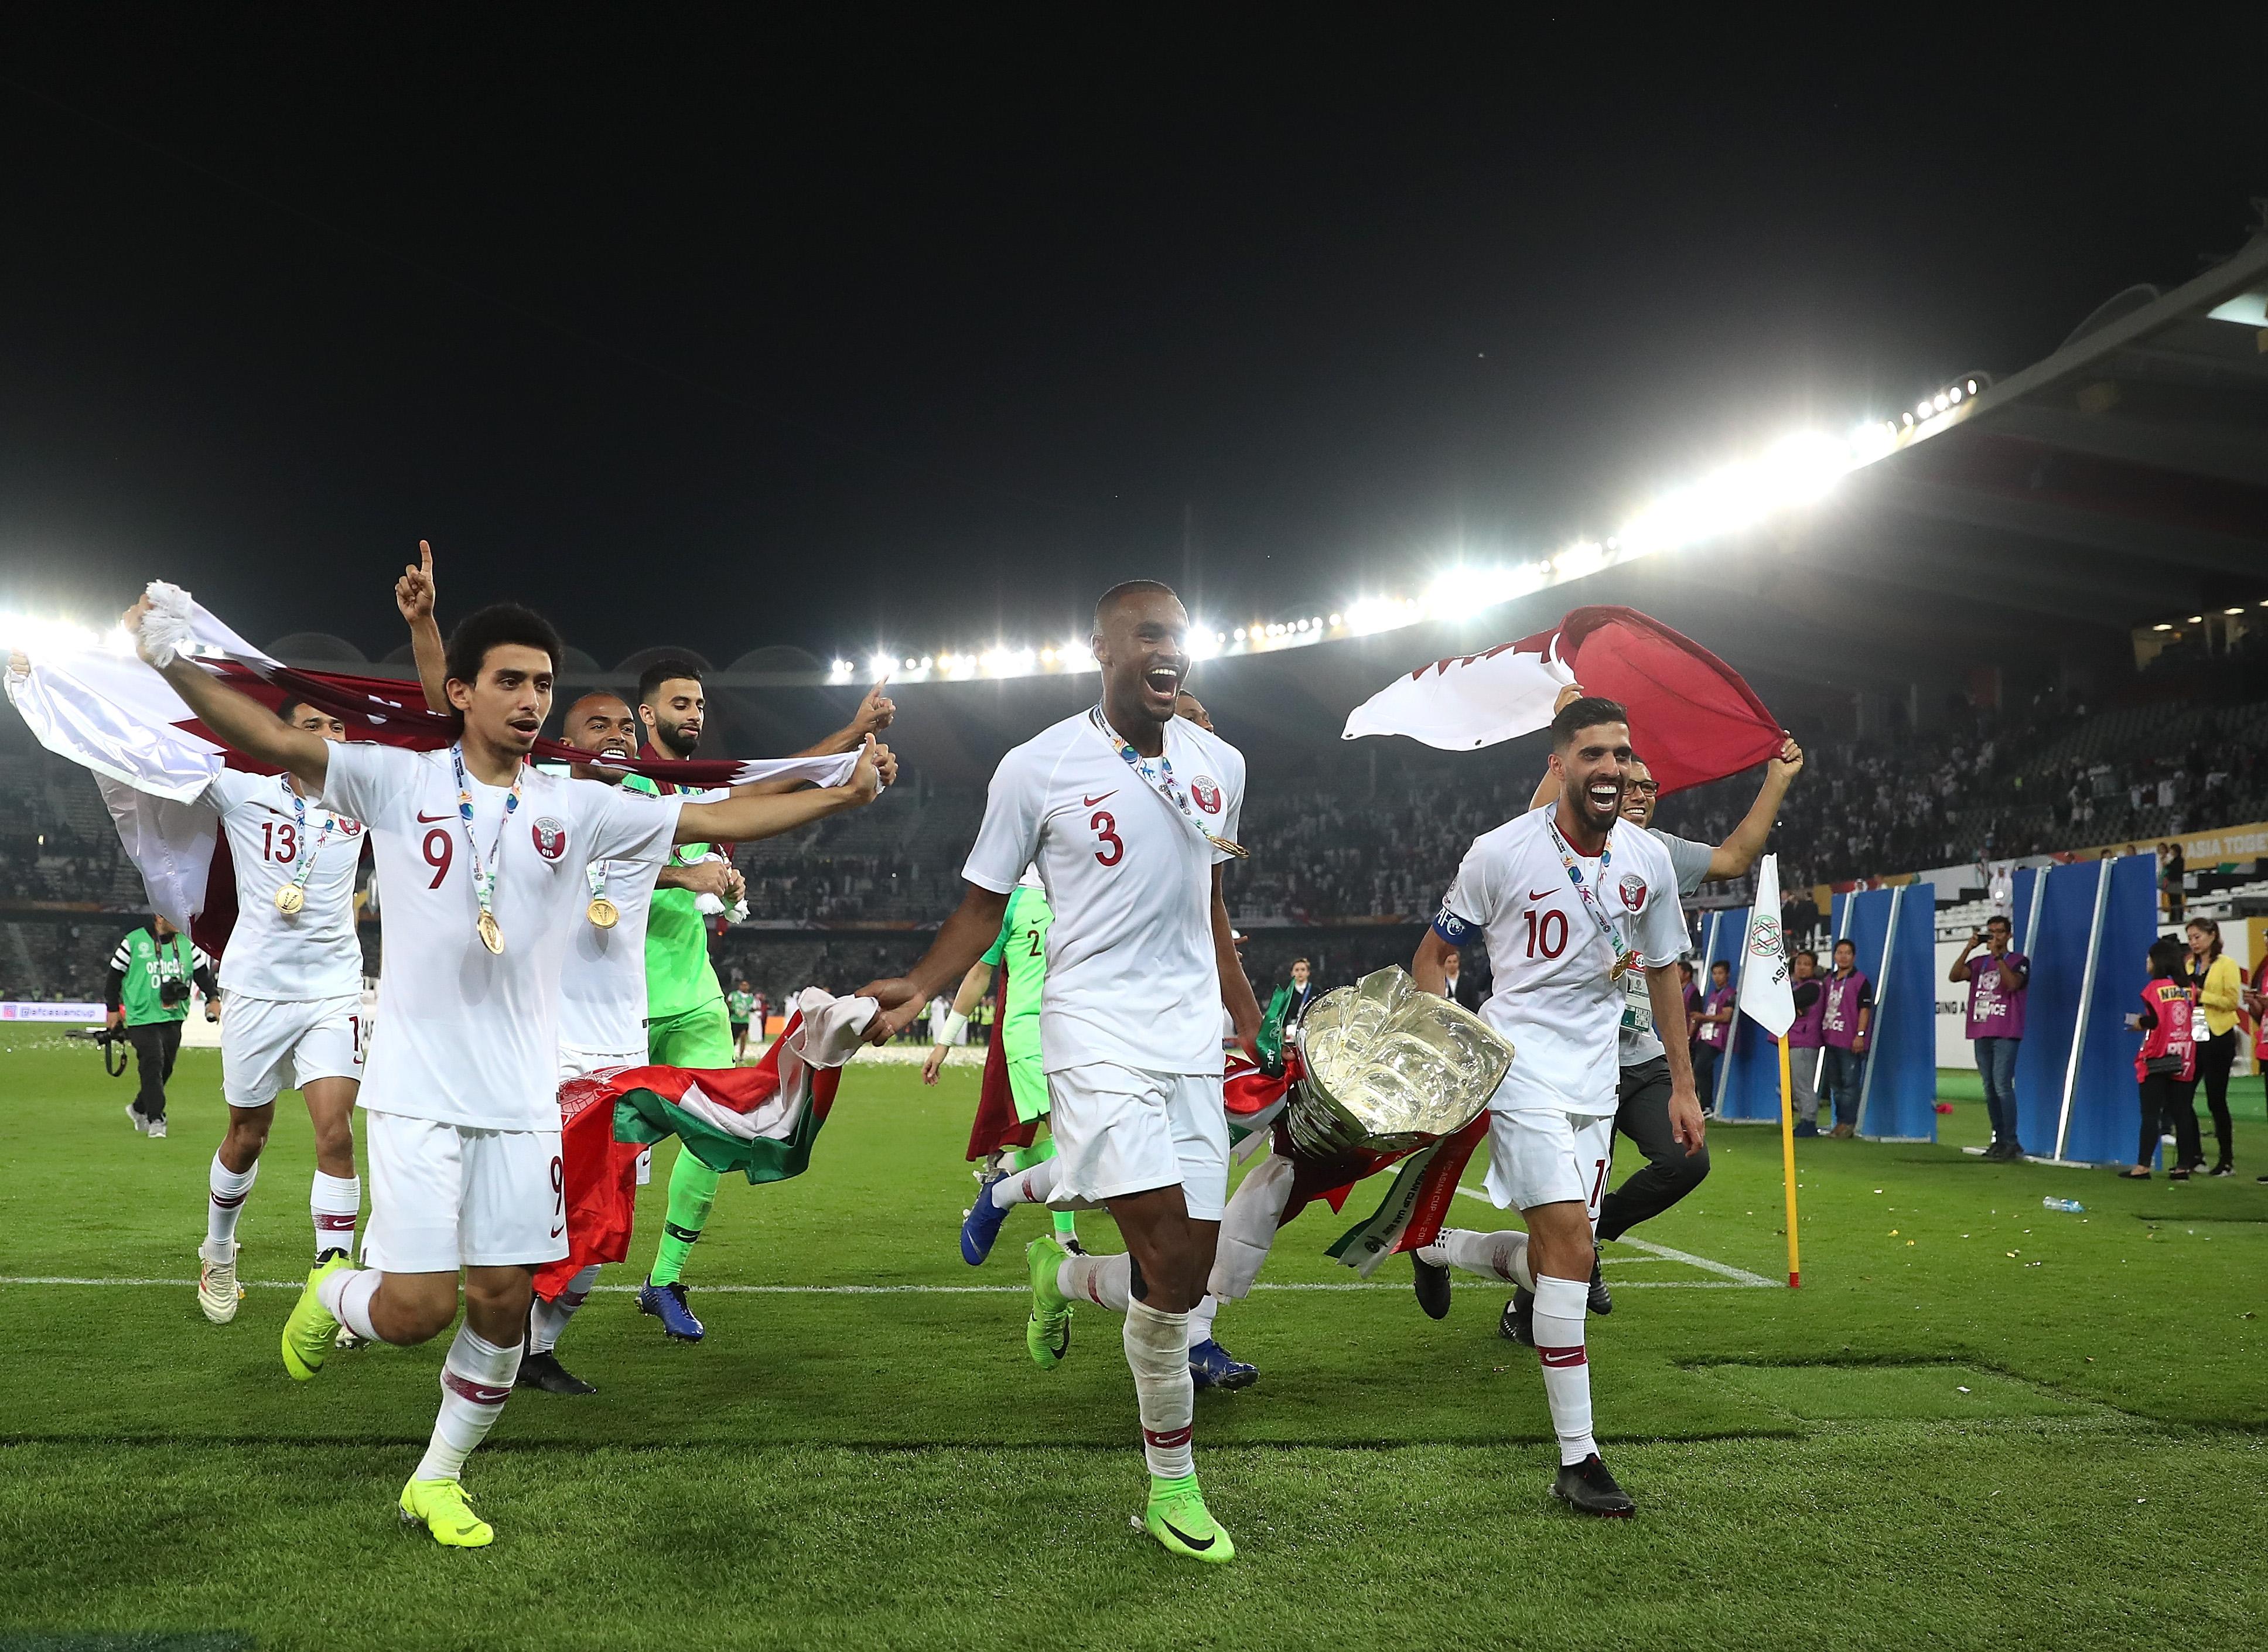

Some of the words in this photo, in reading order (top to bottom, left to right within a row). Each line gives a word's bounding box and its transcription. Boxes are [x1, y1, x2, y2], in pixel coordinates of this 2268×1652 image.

[261, 822, 296, 863] 13
[1091, 811, 1123, 866] 3
[1548, 822, 1561, 842] TOGETHER
[423, 828, 453, 889] 9
[541, 848, 555, 857] QFA
[2187, 838, 2222, 858] ASIA
[1027, 930, 1047, 957] 2
[1524, 909, 1569, 959] 10
[551, 1156, 563, 1216] 9
[1403, 1190, 1416, 1208] CUP
[1430, 1194, 1440, 1211] CUP
